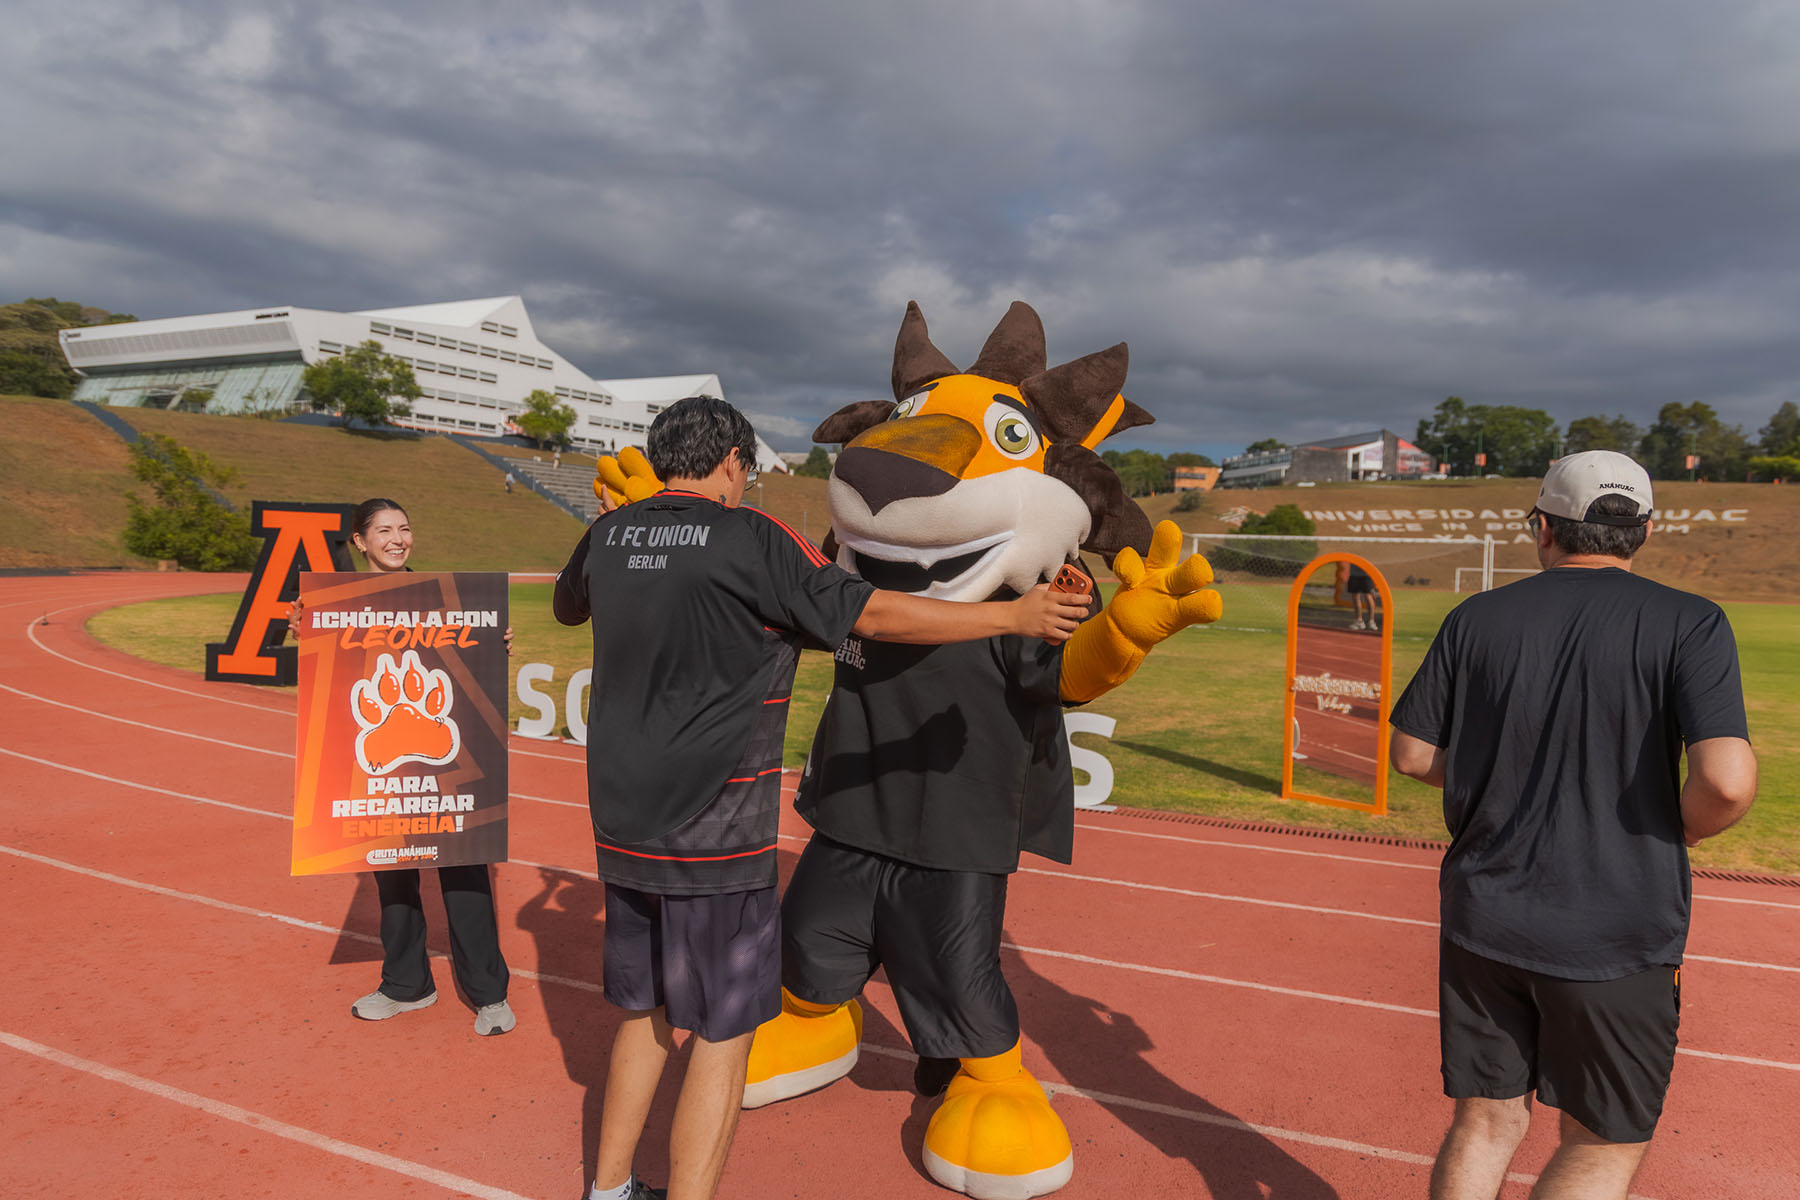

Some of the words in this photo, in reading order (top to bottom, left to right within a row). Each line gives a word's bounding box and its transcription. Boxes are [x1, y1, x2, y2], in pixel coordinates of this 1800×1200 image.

[1599, 482, 1635, 493] ANÁHUAC
[605, 525, 617, 546] 1.
[620, 525, 647, 547] FC
[647, 524, 711, 547] UNION
[1347, 522, 1424, 533] VINCE
[1441, 522, 1468, 531] IN
[627, 555, 668, 569] BERLIN
[446, 610, 498, 628] CON
[340, 622, 479, 650] LEONEL
[835, 649, 866, 670] HUAC
[367, 775, 439, 795] PARA
[331, 794, 475, 818] RECARGAR
[342, 811, 465, 838] ENERGÍA!
[398, 844, 438, 857] ANÁHUAC
